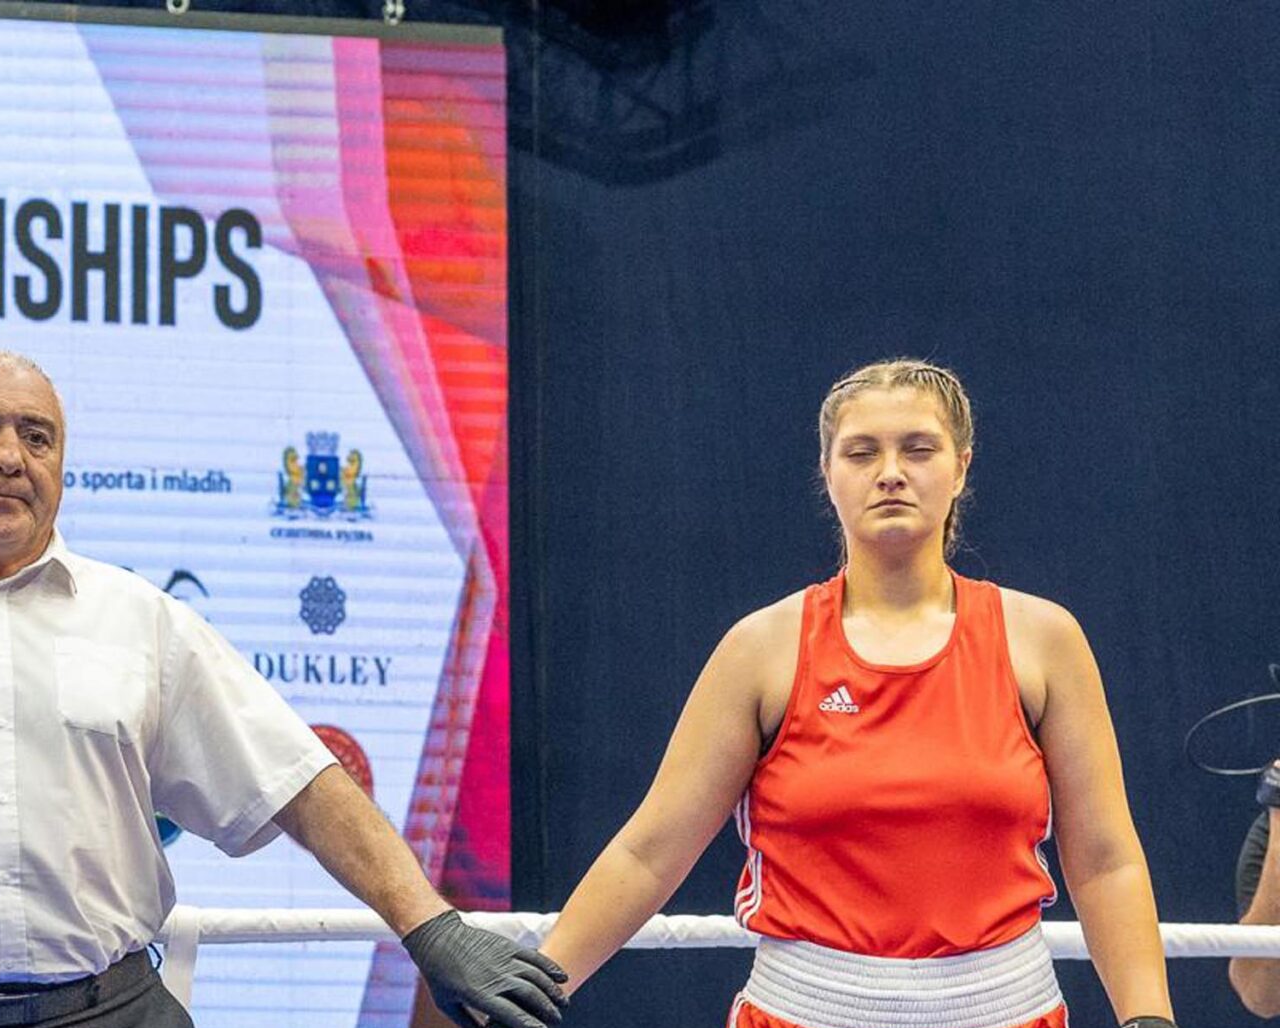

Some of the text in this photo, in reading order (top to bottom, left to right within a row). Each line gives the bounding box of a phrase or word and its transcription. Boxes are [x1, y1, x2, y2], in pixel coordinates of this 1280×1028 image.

[81, 470, 145, 493] sporta
[151, 468, 157, 491] i
[163, 469, 232, 493] mladih
[254, 652, 392, 686] DUKLEY
